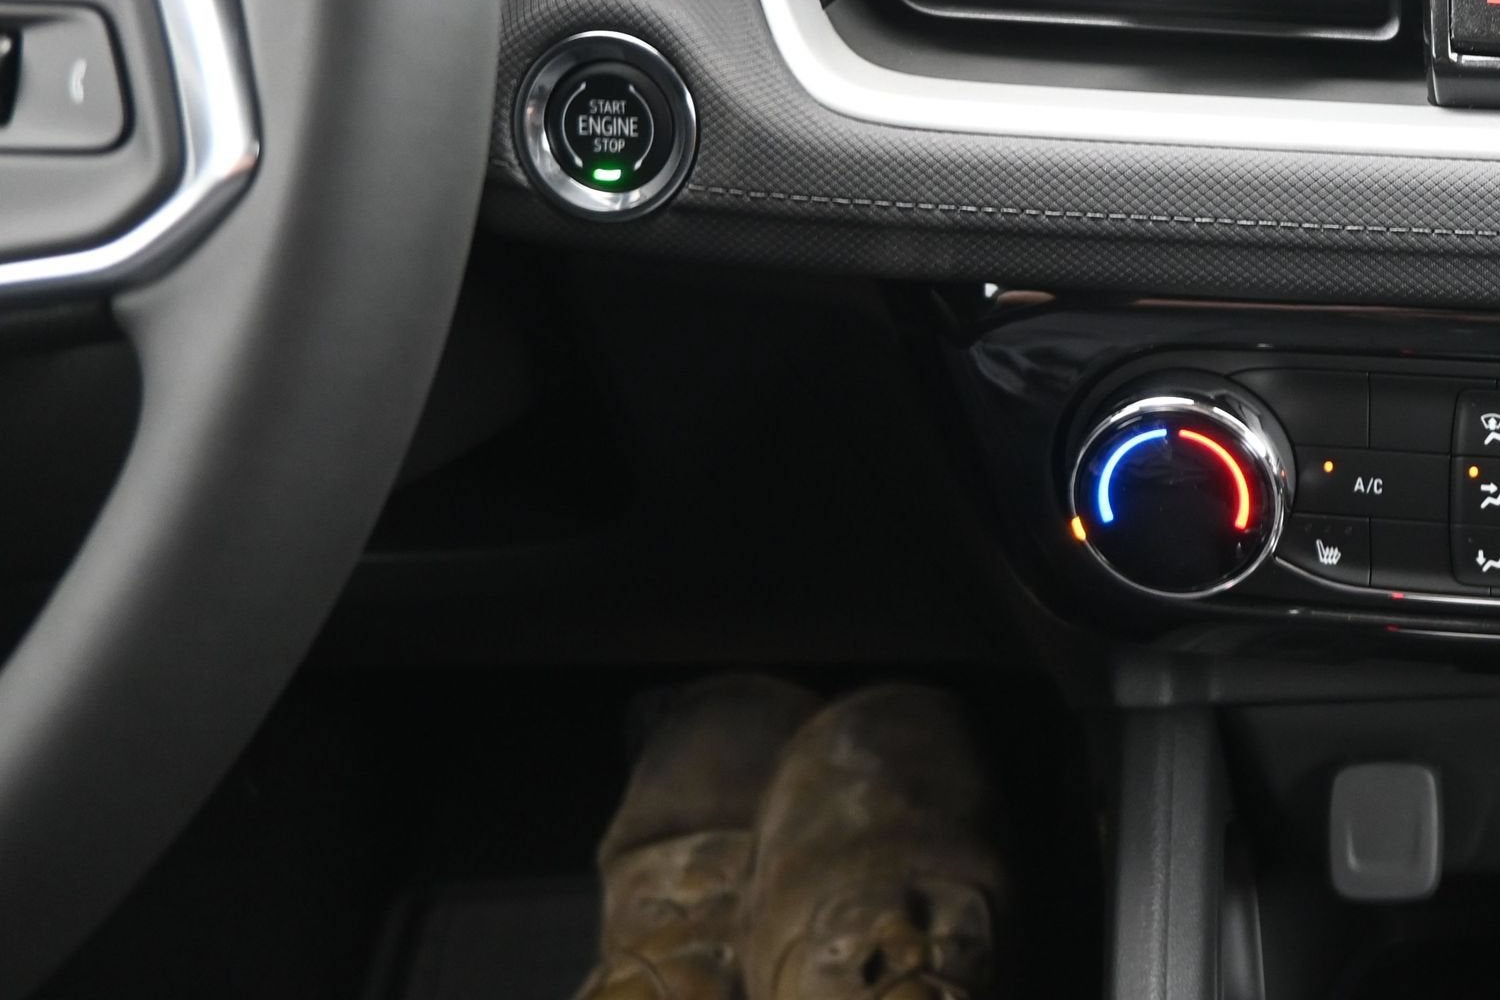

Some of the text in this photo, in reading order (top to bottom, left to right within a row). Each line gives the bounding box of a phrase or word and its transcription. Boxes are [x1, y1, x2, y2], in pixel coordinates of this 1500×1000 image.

[589, 99, 626, 114] START
[578, 115, 639, 137] ENGINE
[594, 137, 625, 152] STOP
[1353, 477, 1383, 495] A/C
